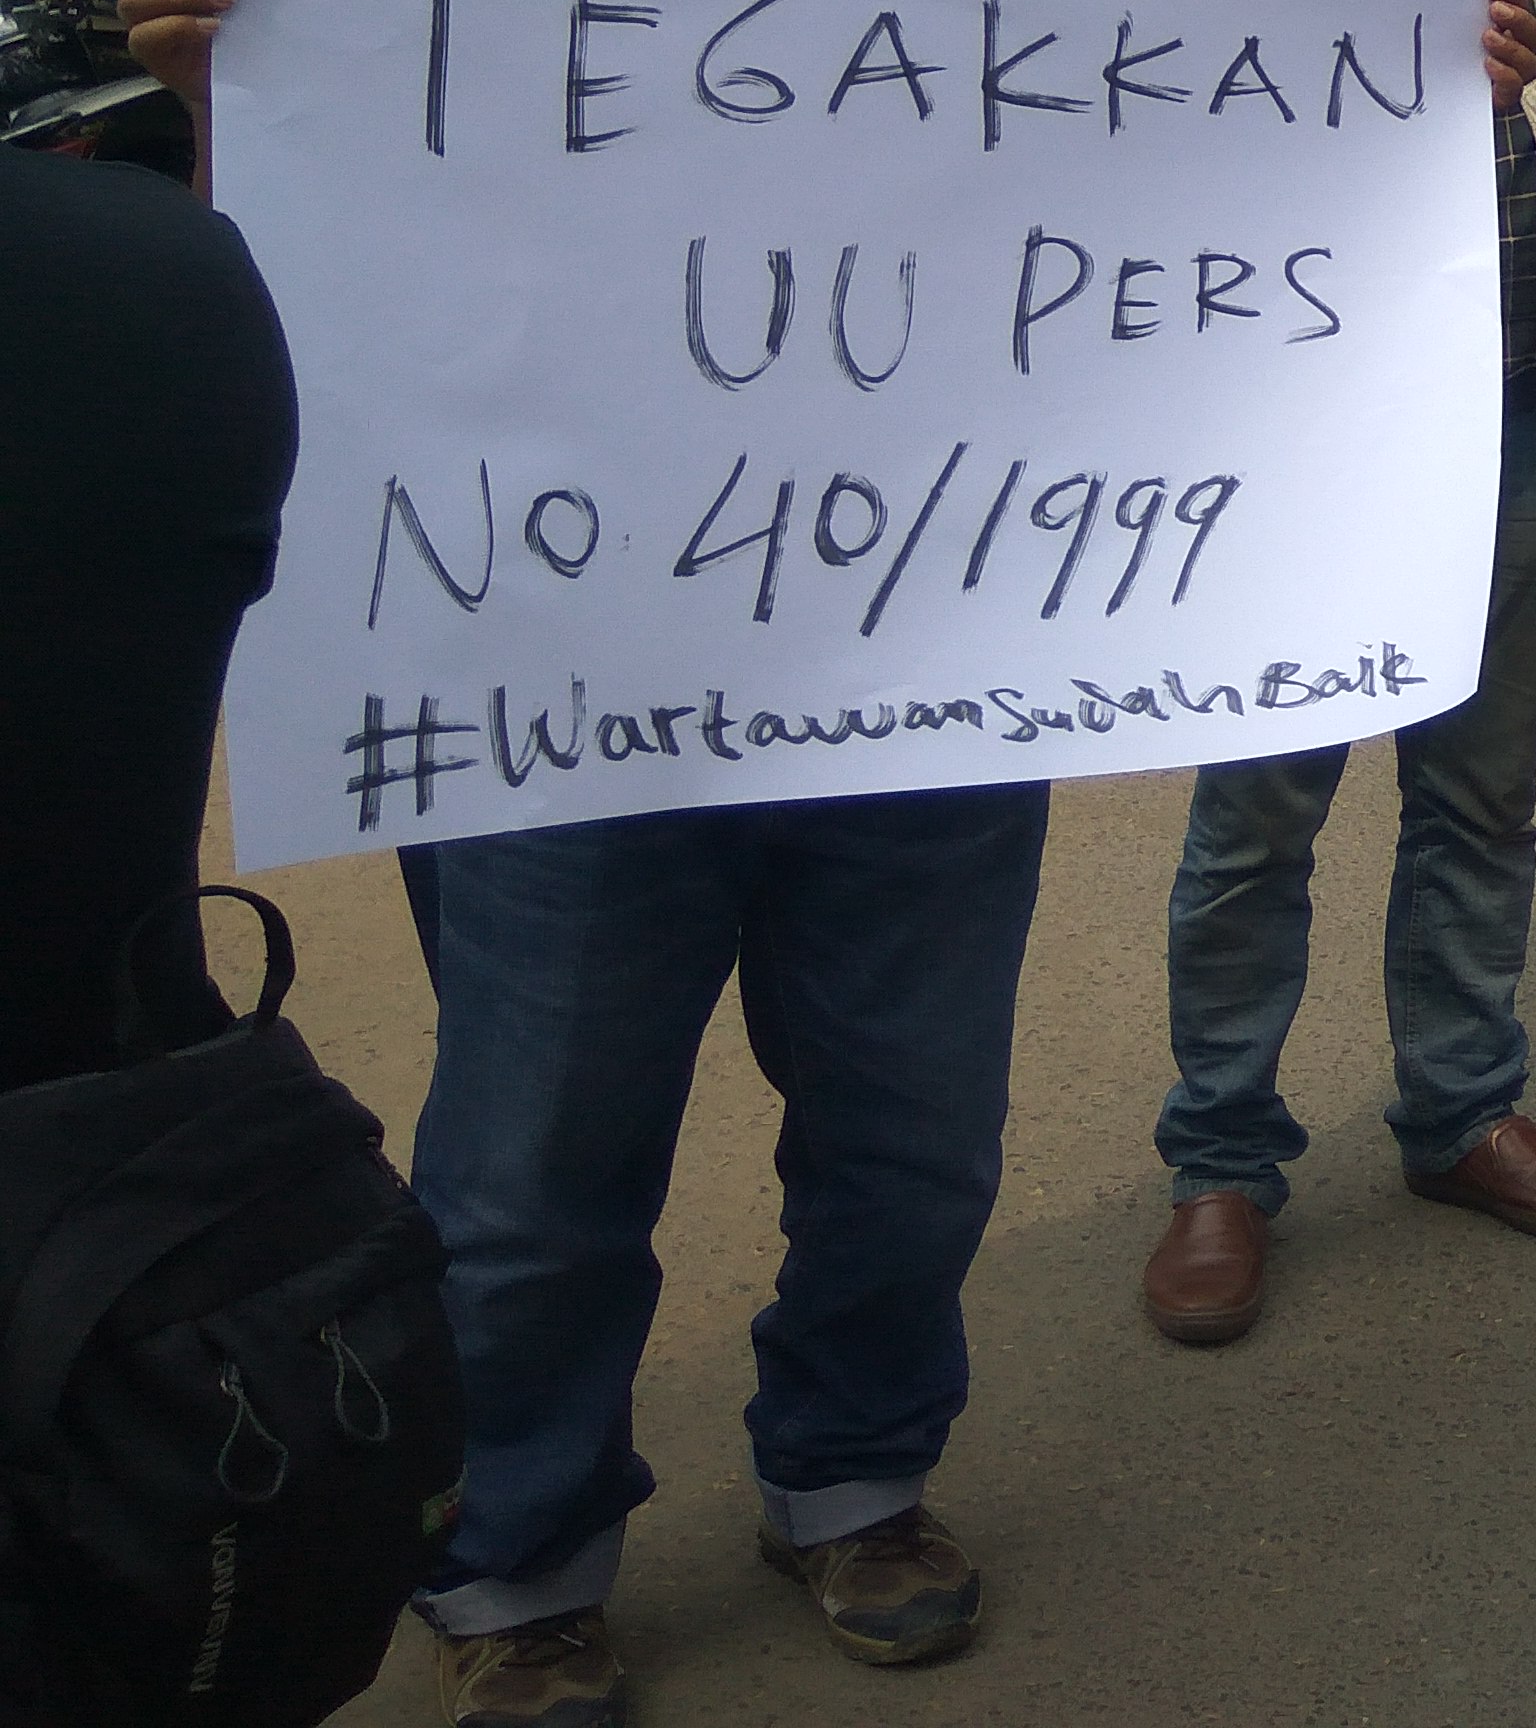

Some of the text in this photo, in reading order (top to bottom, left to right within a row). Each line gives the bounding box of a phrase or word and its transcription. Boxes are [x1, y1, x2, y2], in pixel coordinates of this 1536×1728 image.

[683, 225, 1342, 391] UU PERS
[671, 443, 1241, 636] 40/1999
